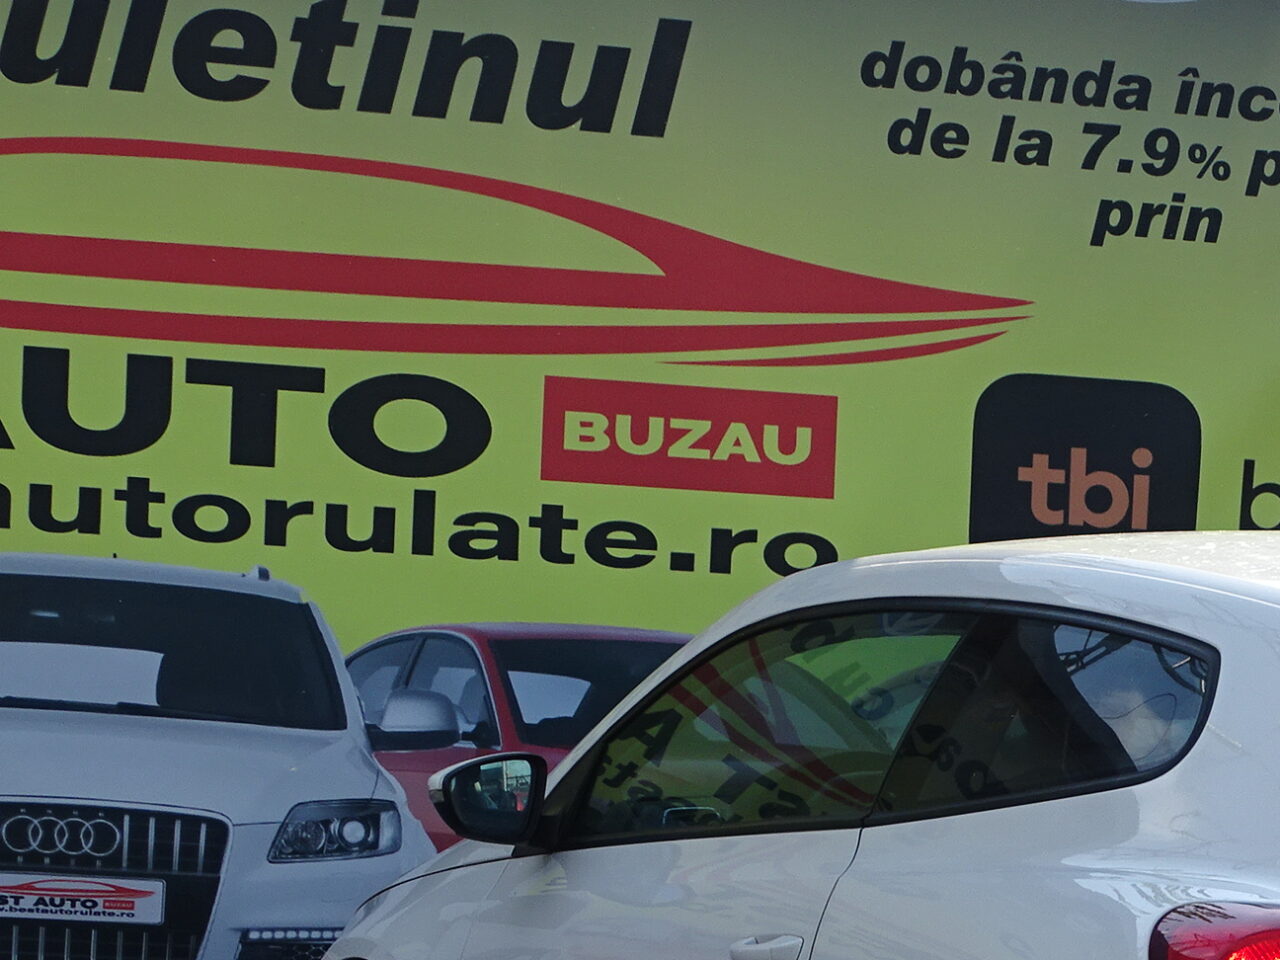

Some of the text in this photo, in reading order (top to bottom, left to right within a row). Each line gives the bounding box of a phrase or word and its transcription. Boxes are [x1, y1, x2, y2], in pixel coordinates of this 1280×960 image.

[860, 41, 1153, 111] dobânda
[887, 108, 969, 158] de
[992, 115, 1053, 166] la
[1080, 122, 1231, 182] 7.9%
[1090, 192, 1224, 246] prin
[0, 345, 492, 478] UTO
[562, 411, 812, 466] BUZAU
[1017, 447, 1153, 530] tbi
[33, 896, 98, 909] AUTO
